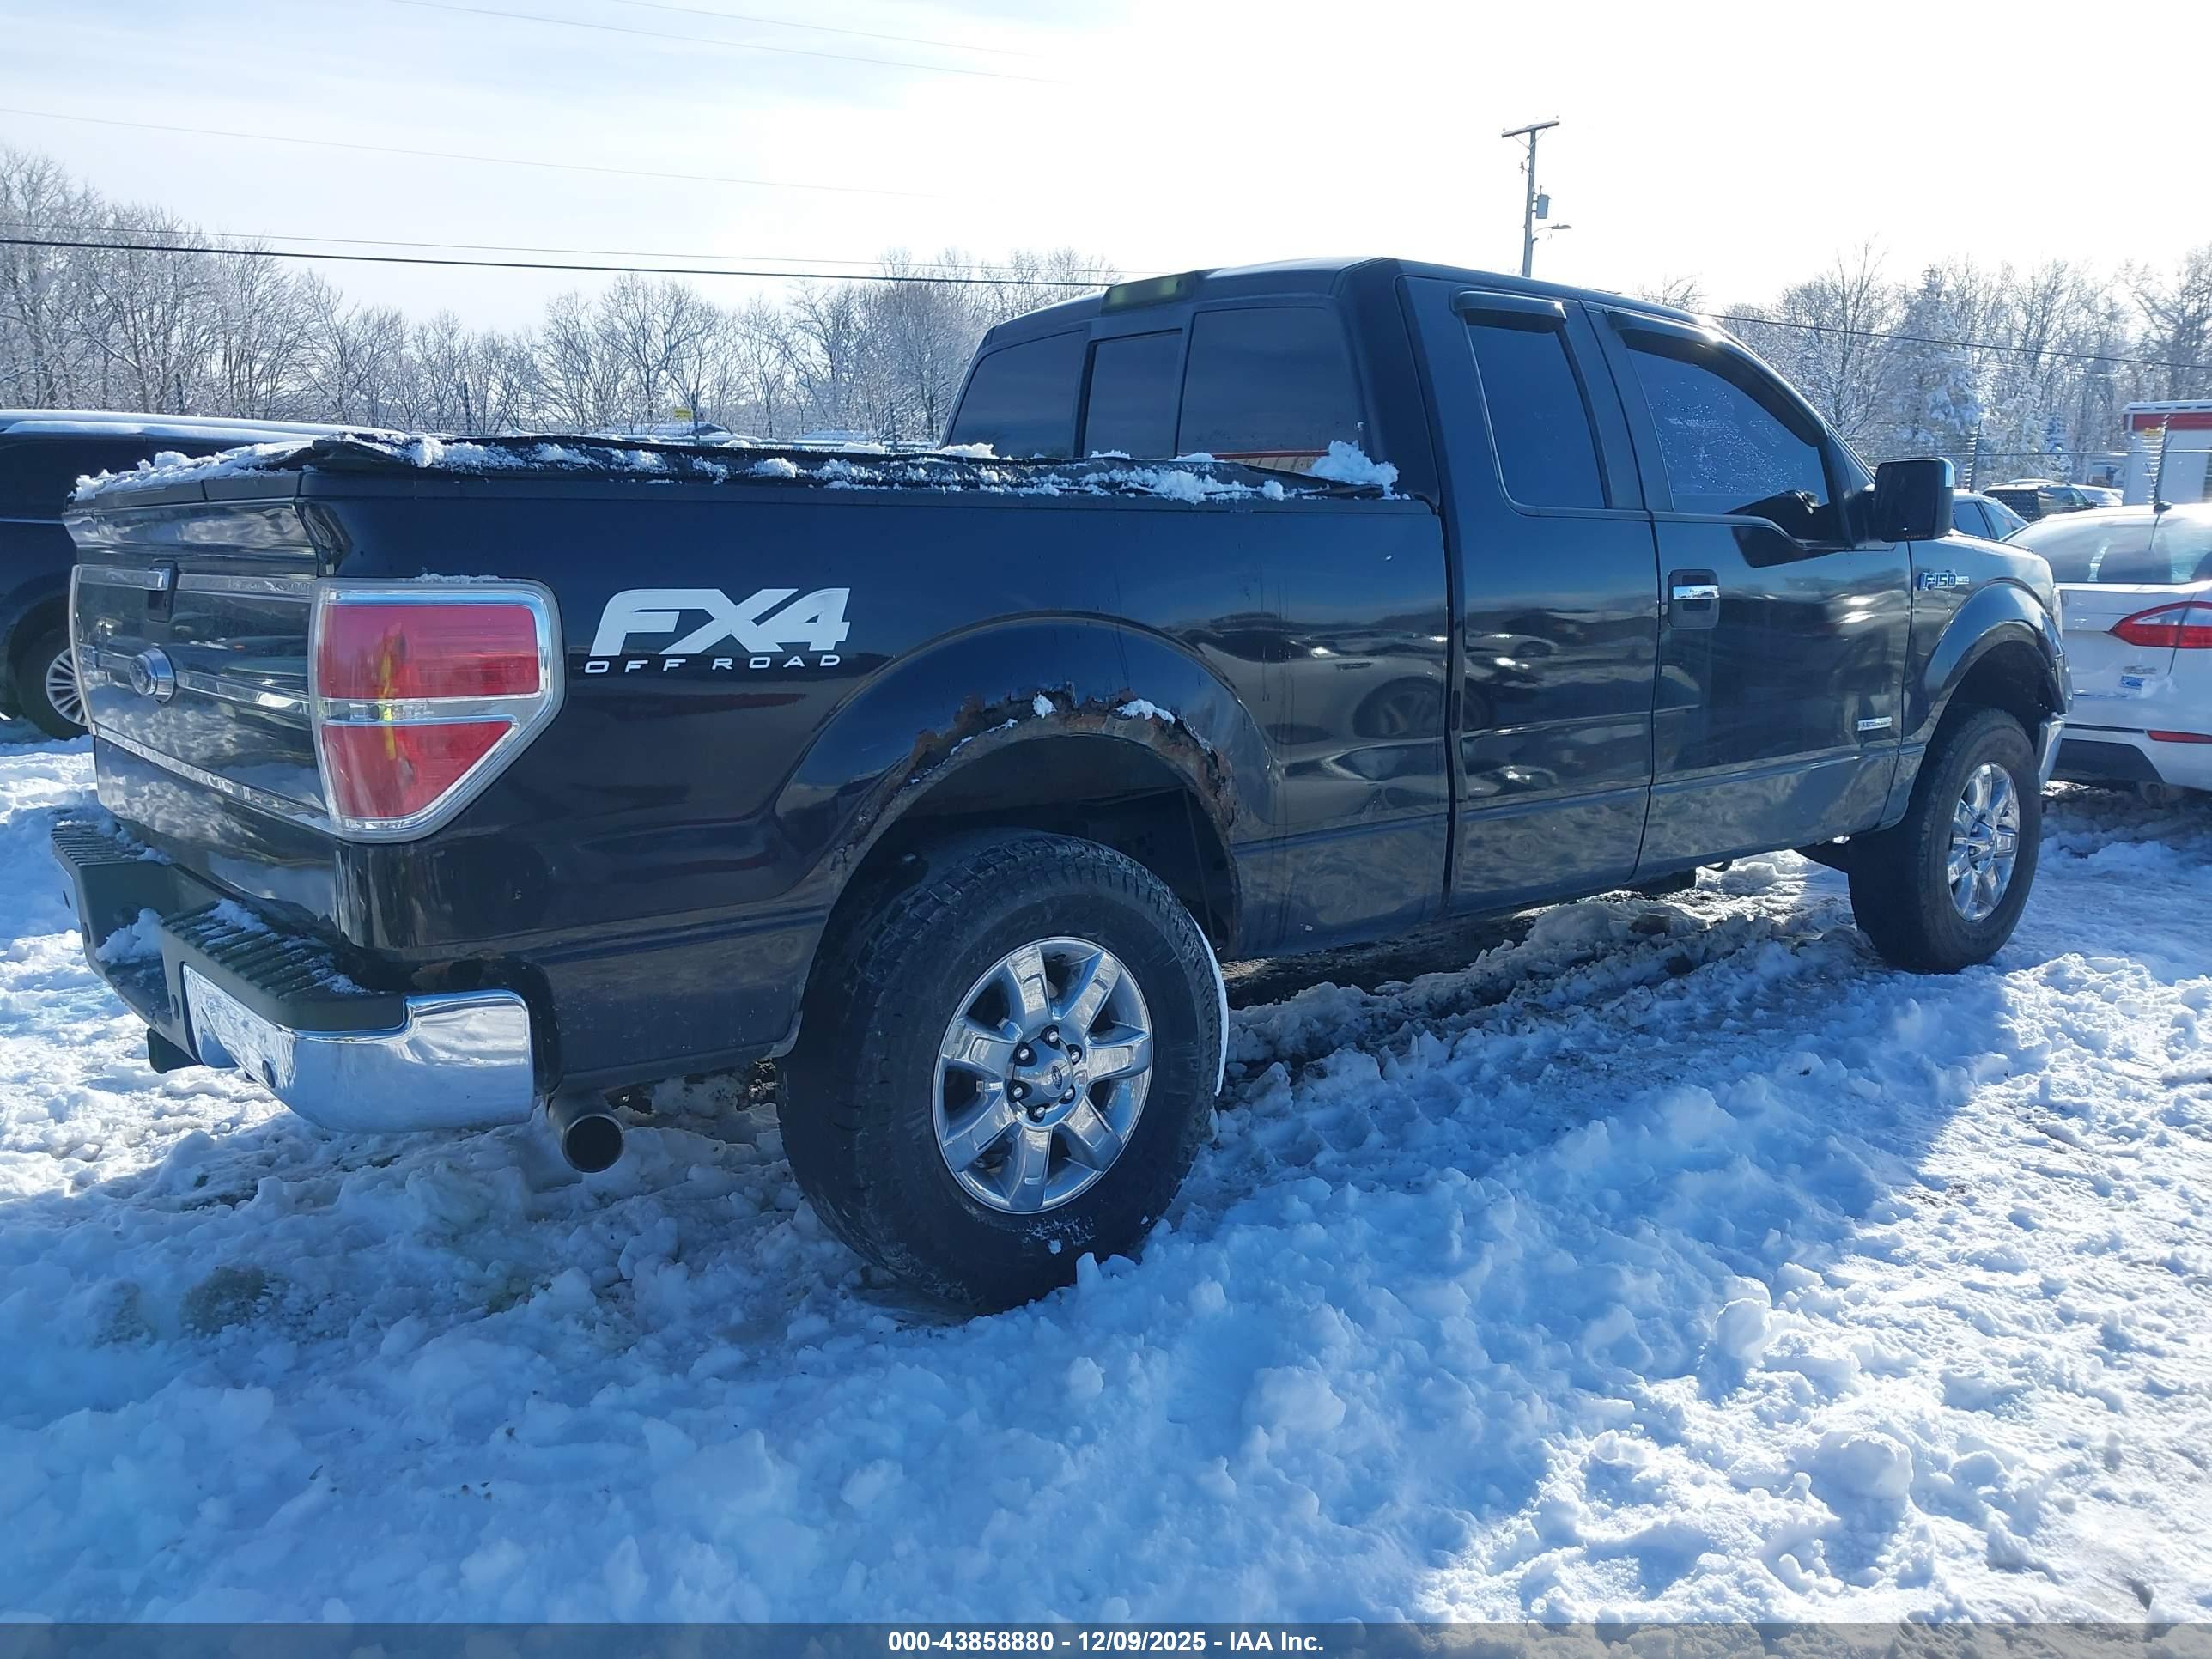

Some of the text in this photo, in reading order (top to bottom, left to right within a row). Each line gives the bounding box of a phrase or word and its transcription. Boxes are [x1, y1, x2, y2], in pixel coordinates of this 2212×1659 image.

[589, 587, 851, 657] FX4
[584, 654, 841, 674] OFF ROAD
